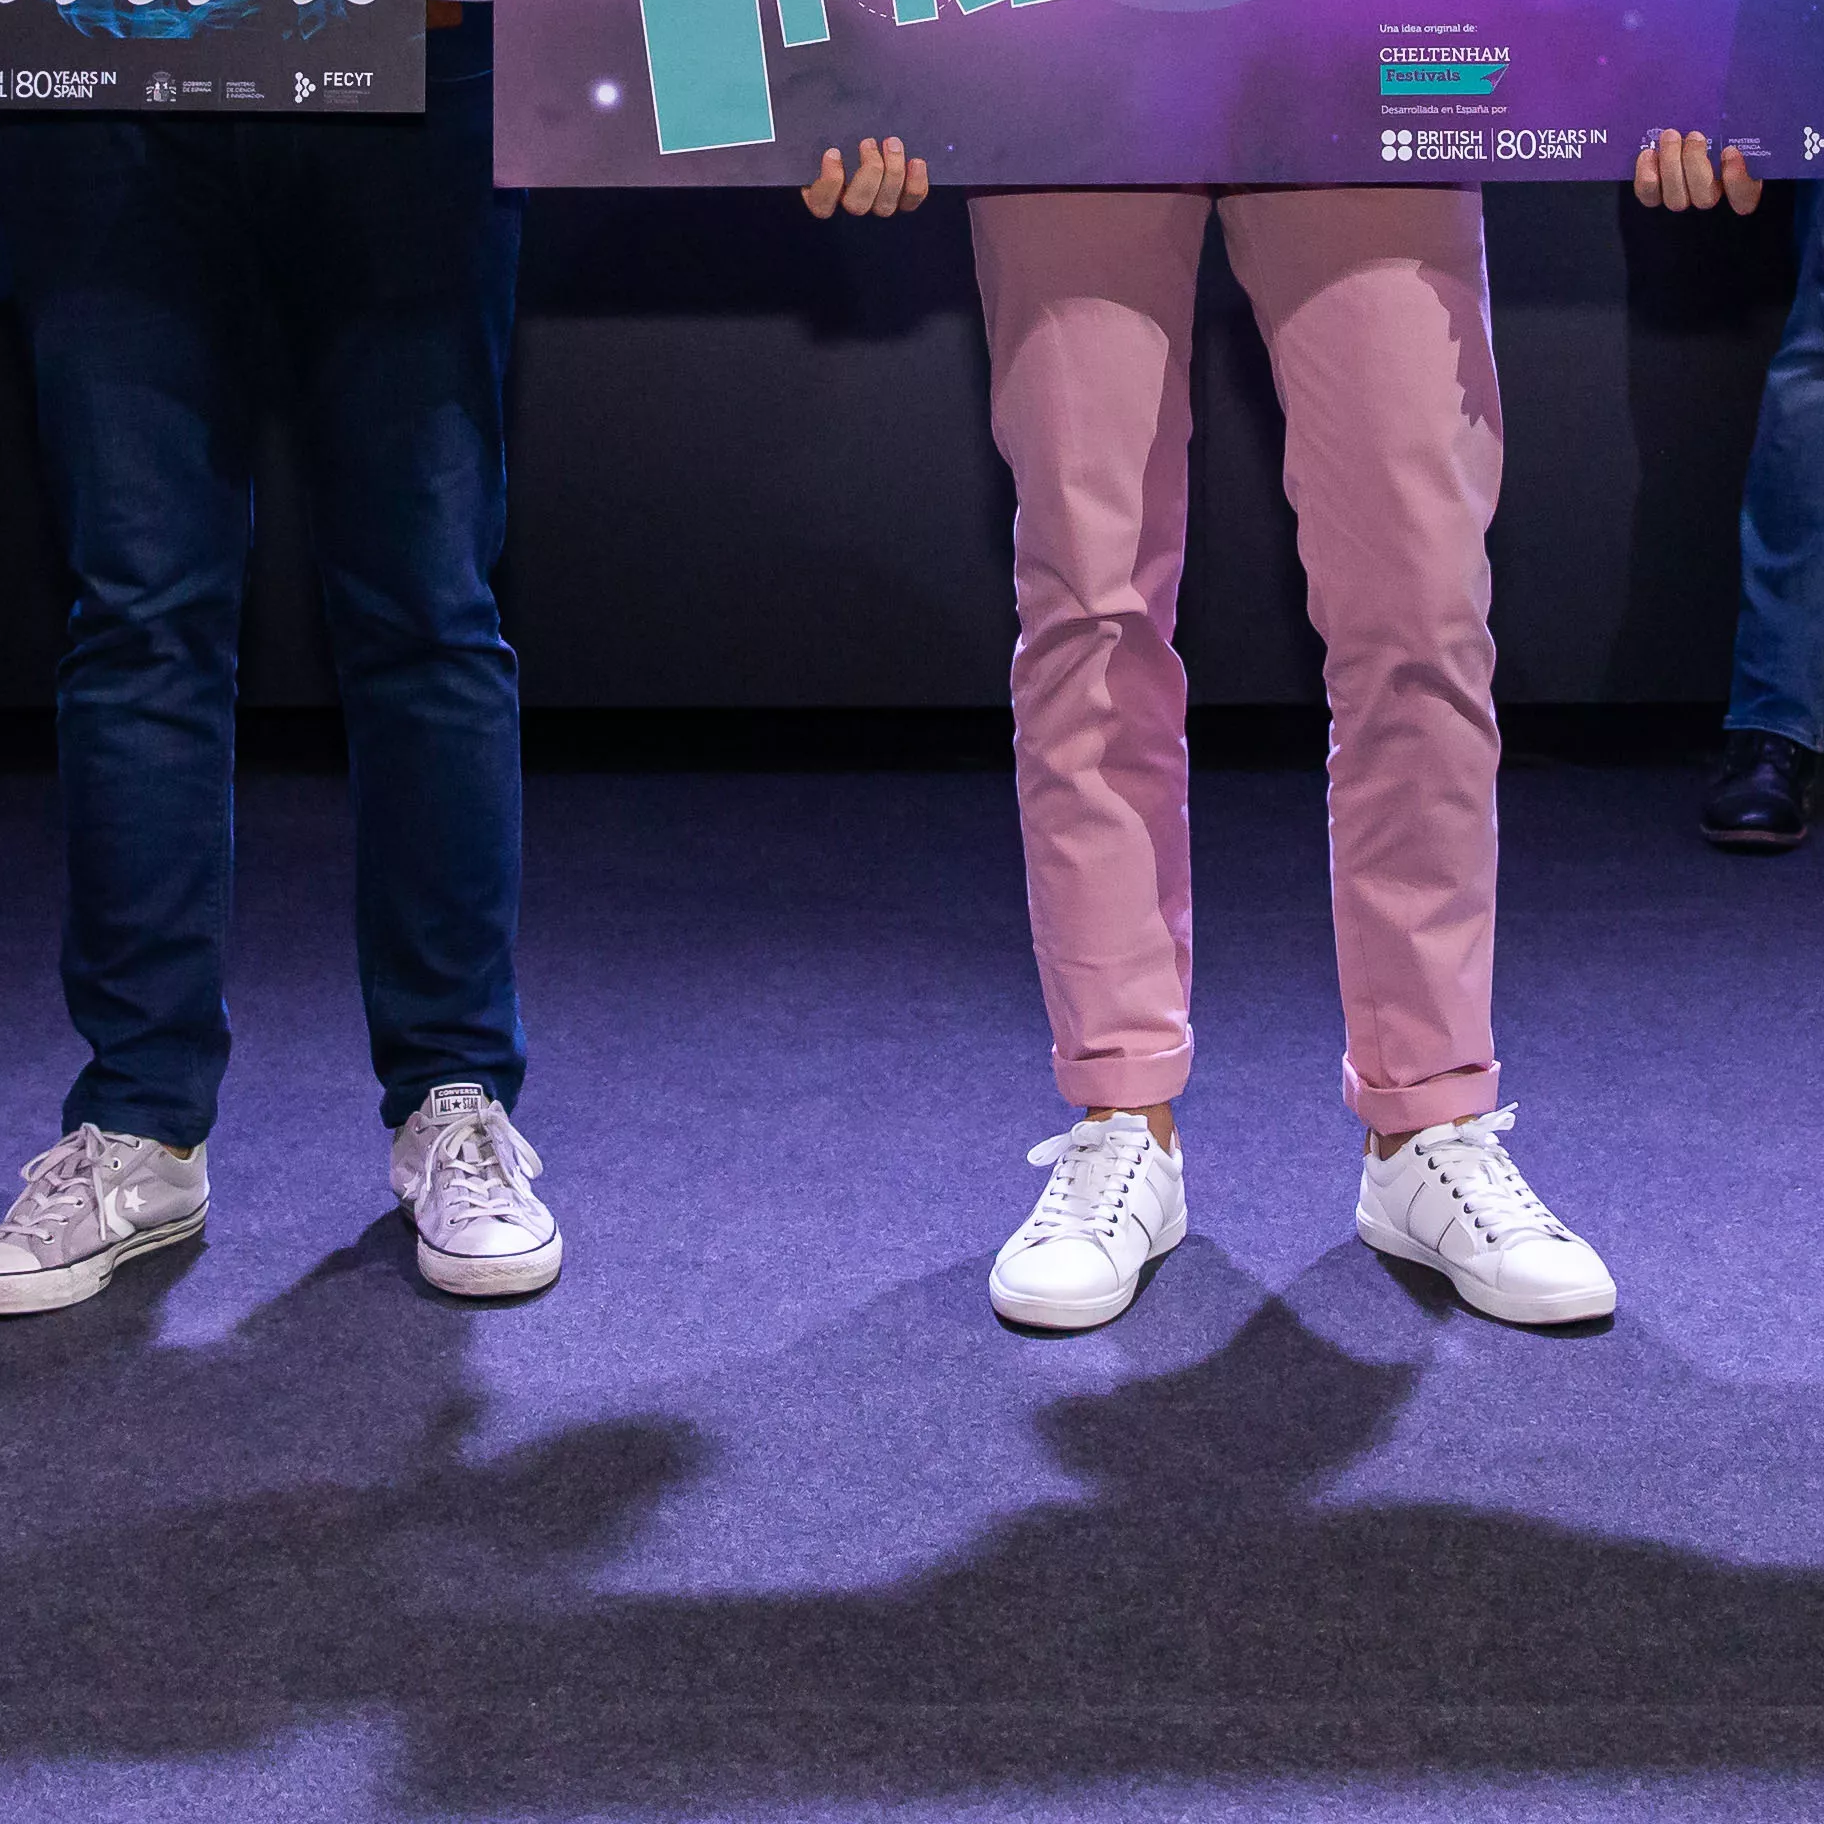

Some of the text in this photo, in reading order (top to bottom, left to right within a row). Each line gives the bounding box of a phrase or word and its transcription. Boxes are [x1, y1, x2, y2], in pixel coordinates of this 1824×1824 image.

[1379, 24, 1399, 33] Una
[1401, 24, 1422, 33] idea
[1424, 23, 1460, 34] original
[1379, 47, 1510, 62] CHELTENHAM
[53, 70, 117, 85] YEARS IN
[323, 72, 374, 87] FECYT
[1385, 68, 1461, 82] Festivals
[15, 70, 52, 98] 80
[53, 84, 93, 99] SPAIN
[1381, 104, 1508, 115] Desarrollada en España por
[1417, 130, 1483, 145] BRITISH
[1537, 129, 1607, 144] YEARS IN
[1496, 129, 1536, 160] 80
[1538, 145, 1582, 159] SPAIN
[1416, 145, 1487, 160] COUNCIL
[438, 1088, 479, 1096] CONVERSE
